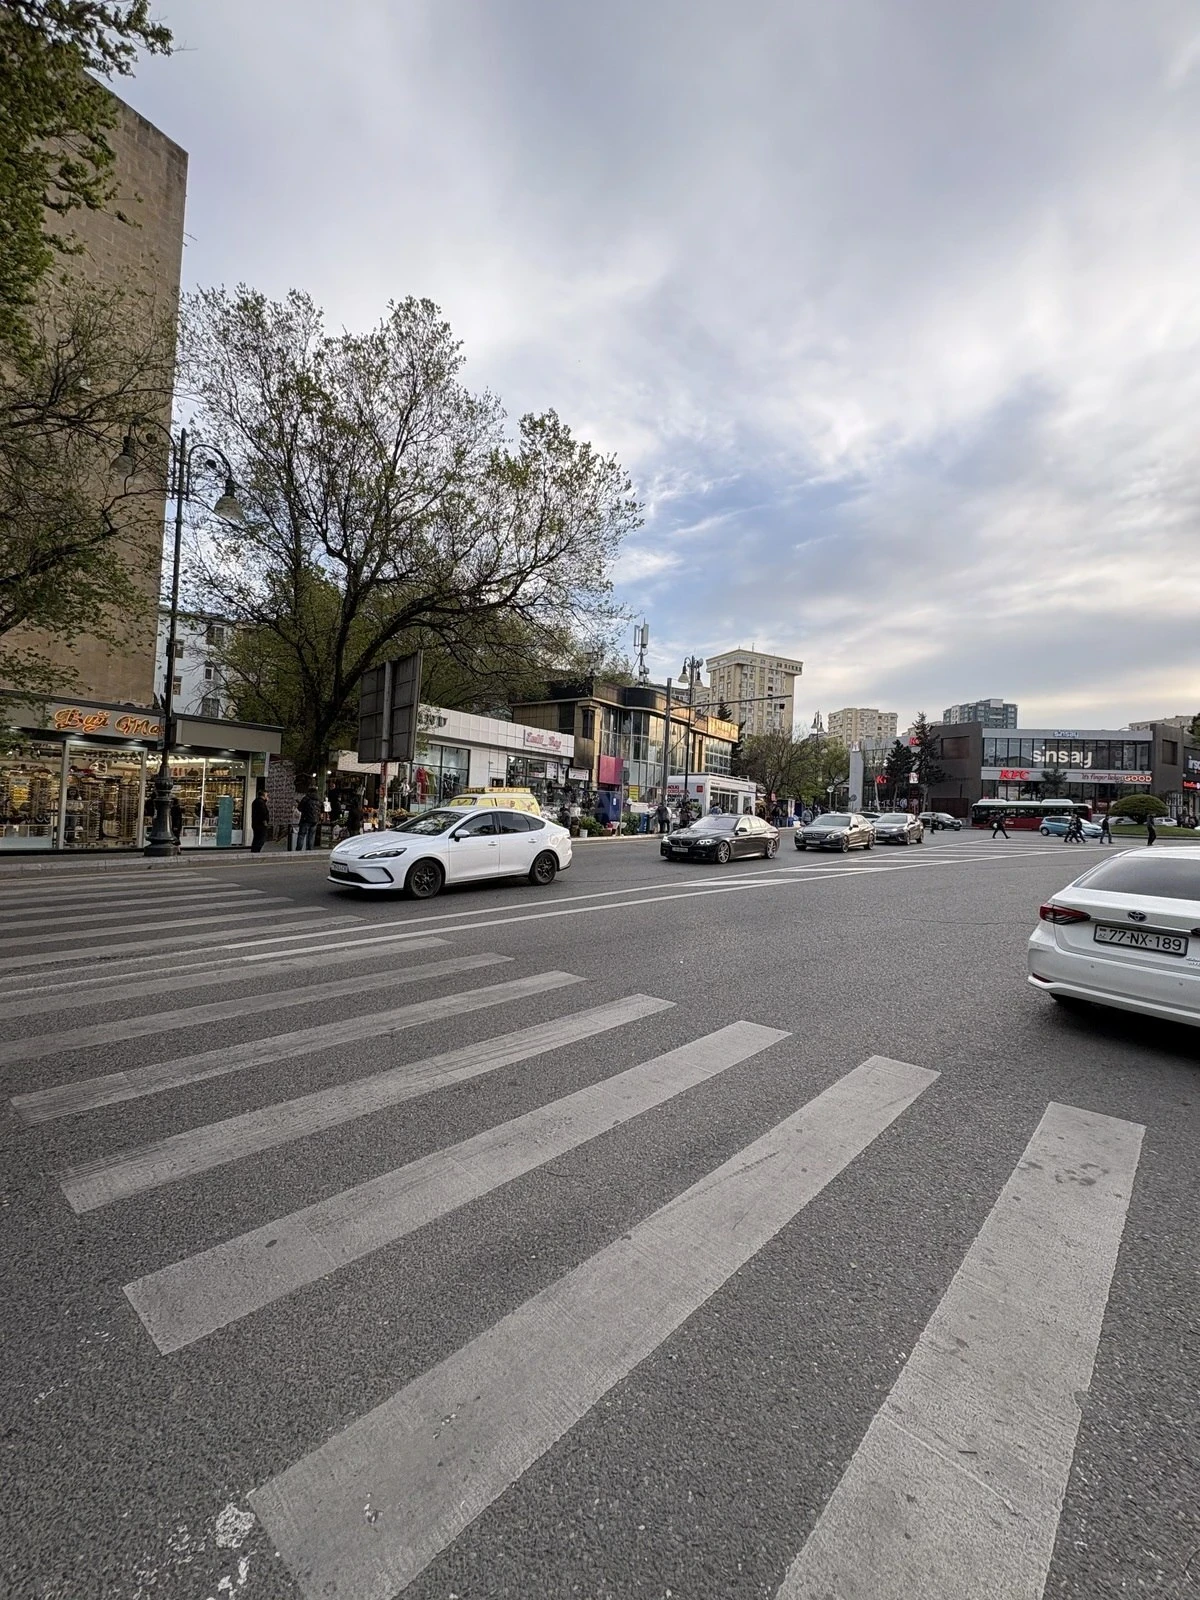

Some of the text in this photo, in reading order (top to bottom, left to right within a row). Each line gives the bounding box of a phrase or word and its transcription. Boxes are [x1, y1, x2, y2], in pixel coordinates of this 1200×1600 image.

[1053, 730, 1079, 738] sinsay
[1031, 745, 1093, 768] sinsay
[999, 769, 1030, 780] KFC
[1109, 929, 1182, 951] 77-NX-189
